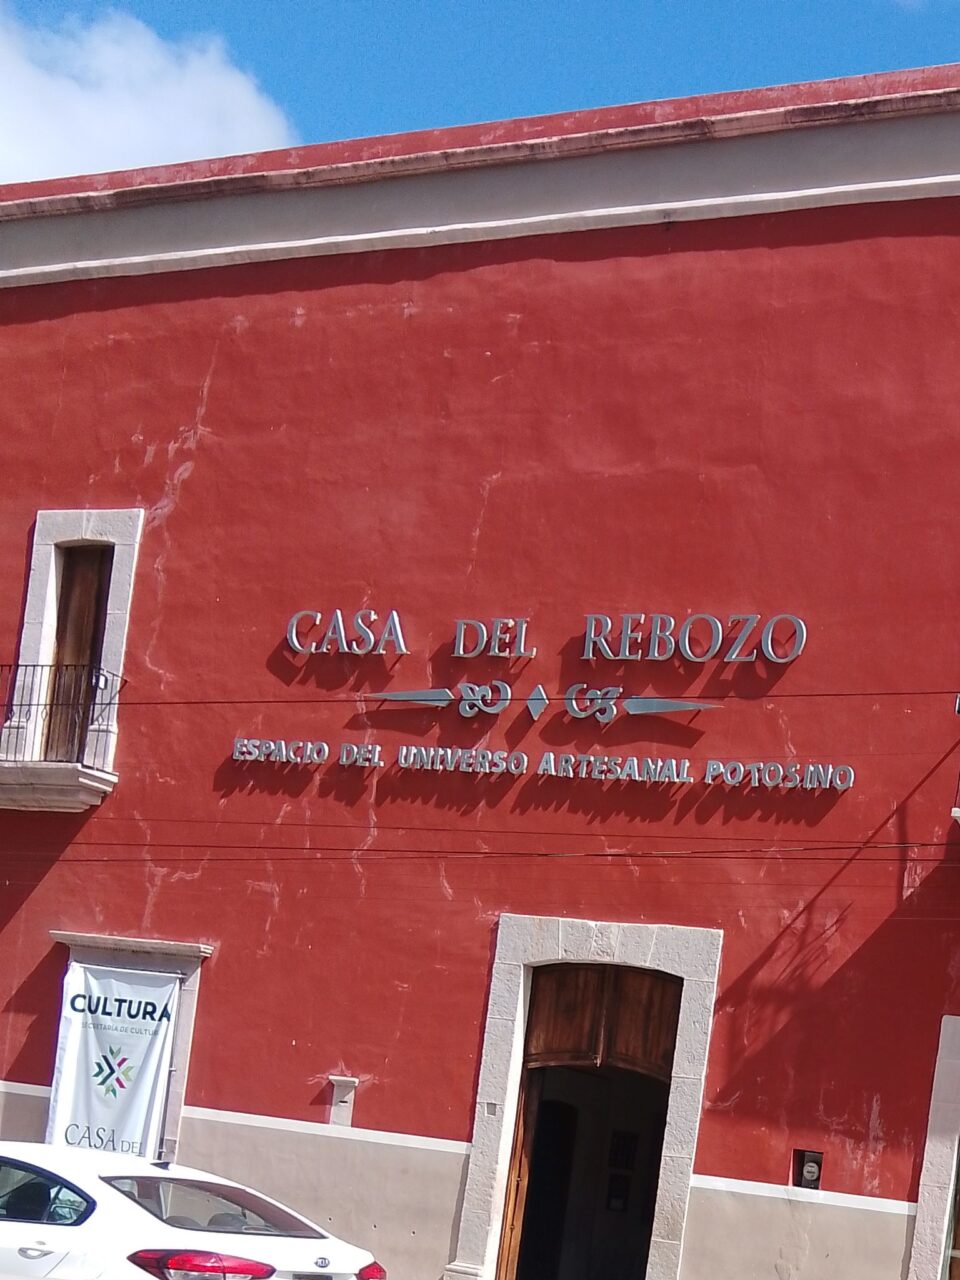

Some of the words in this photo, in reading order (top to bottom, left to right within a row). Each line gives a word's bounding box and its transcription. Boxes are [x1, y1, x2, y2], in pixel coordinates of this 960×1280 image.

[287, 608, 411, 655] CASA
[451, 617, 537, 658] DEL
[580, 613, 807, 663] REBOZO
[232, 738, 329, 764] ESPACIO
[339, 743, 384, 767] DEL
[398, 745, 528, 775] UNIVERSO
[537, 752, 693, 783] ARTESANAL
[705, 760, 854, 790] POTOSINO
[70, 993, 171, 1022] CULTURA
[64, 1123, 117, 1151] CASA
[121, 1140, 144, 1156] DEL
